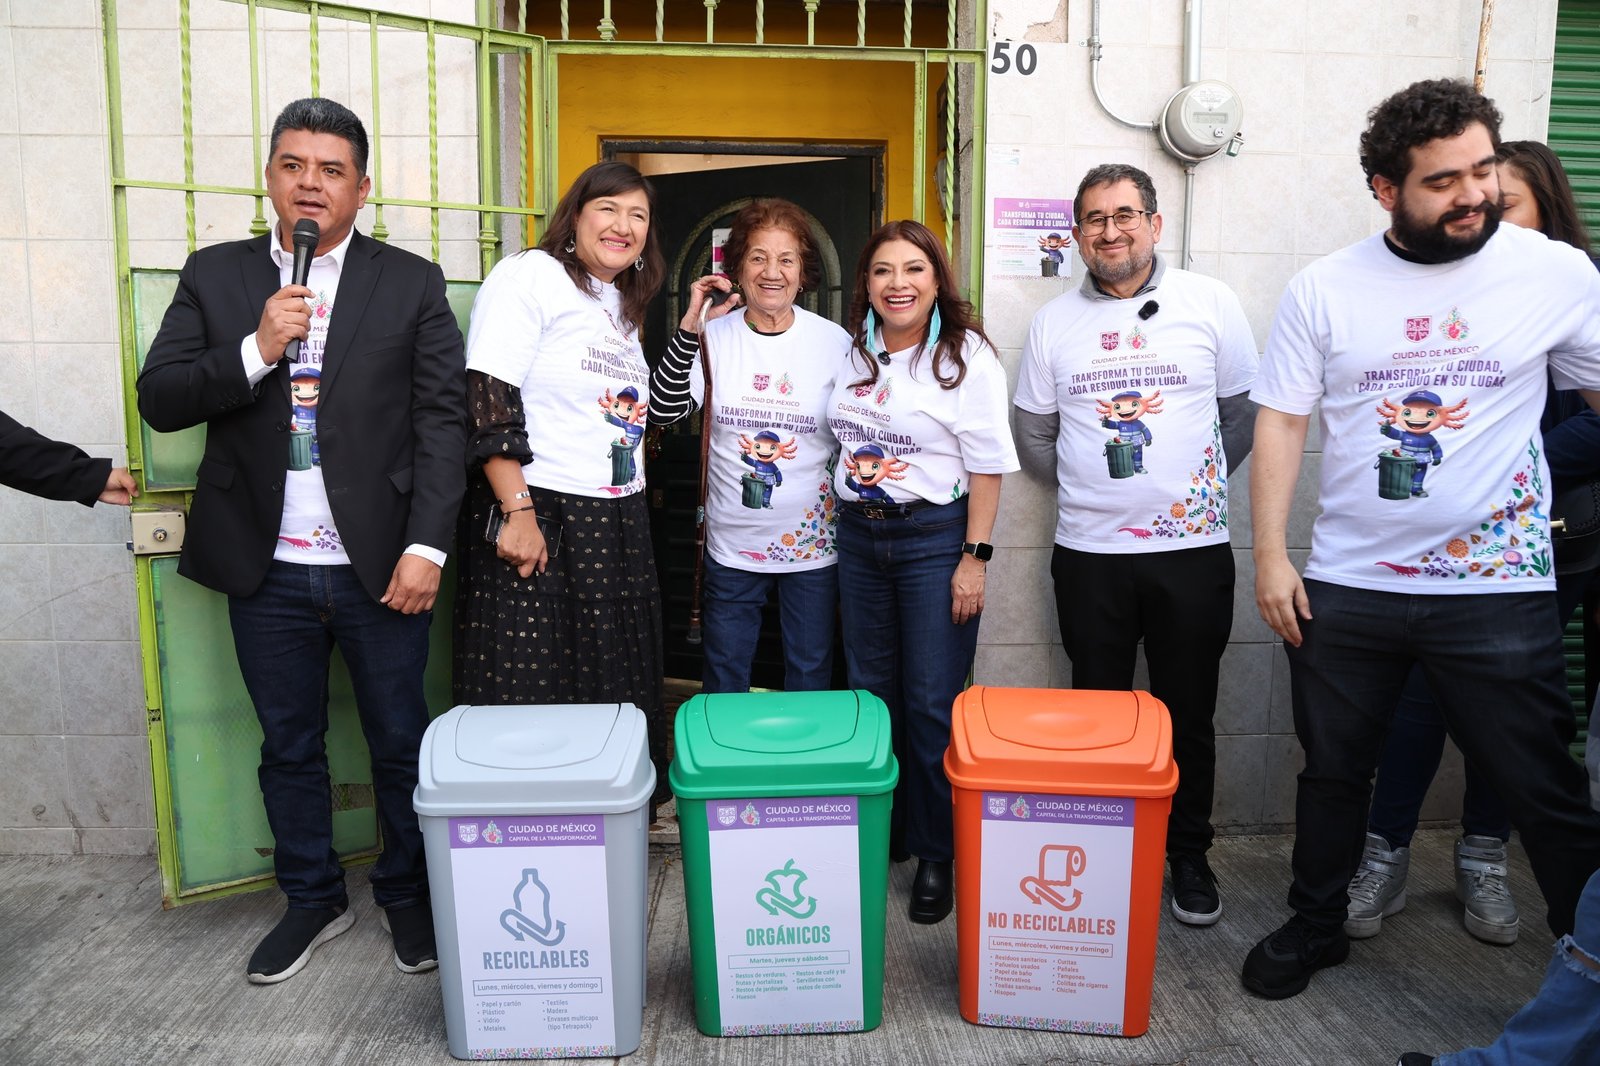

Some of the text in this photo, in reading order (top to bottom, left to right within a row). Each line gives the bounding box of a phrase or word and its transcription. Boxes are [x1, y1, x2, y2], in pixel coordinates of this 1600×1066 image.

[991, 42, 1038, 75] 50
[1392, 351, 1426, 359] CIUDAD
[581, 359, 602, 374] CADA
[1072, 368, 1128, 384] TRANSFORMA
[1131, 367, 1141, 376] TU
[1145, 364, 1181, 375] CIUDAD,
[1457, 360, 1503, 374] CIUDAD,
[1068, 375, 1188, 395] CADA RESIDUO EN SU LUGAR
[1434, 375, 1448, 386] EN
[1452, 375, 1466, 386] SU
[1471, 375, 1506, 388] LUGAR
[721, 406, 772, 420] TRANSFORMA
[775, 412, 784, 421] TU
[787, 414, 816, 426] CIUDAD,
[838, 403, 860, 414] CIUDAD
[861, 408, 868, 416] DE
[716, 416, 735, 426] CADA
[737, 419, 770, 428] RESIDUO
[795, 425, 818, 434] LUGAR
[867, 426, 876, 439] TU
[878, 430, 916, 446] CIUDAD,
[765, 803, 851, 815] CIUDAD DE MÉXICO
[1036, 801, 1123, 813] CIUDAD DE MÉXICO
[508, 822, 596, 833] CIUDAD DE MÉXICO
[988, 912, 1116, 936] NO RECICLABLES
[746, 924, 831, 947] ORGÁNICOS
[992, 940, 1014, 948] Lunes,
[1015, 941, 1048, 950] miércoles,
[1080, 945, 1109, 954] domingo
[482, 949, 589, 970] RECICLABLES
[477, 984, 500, 992] Lunes,
[501, 983, 536, 991] miércoles,
[569, 982, 598, 990] domingo
